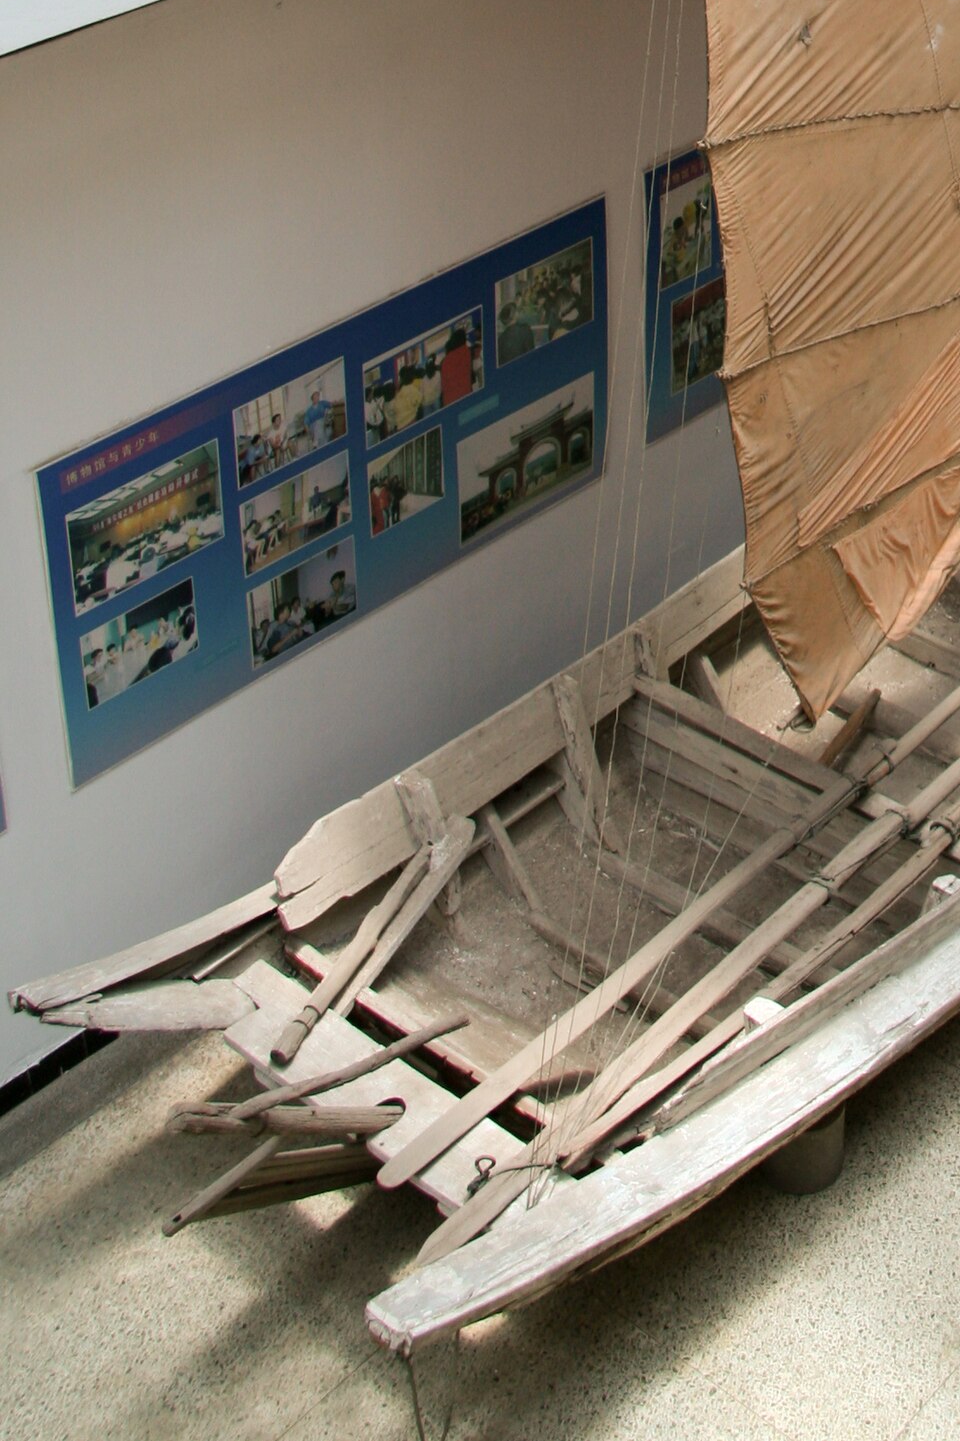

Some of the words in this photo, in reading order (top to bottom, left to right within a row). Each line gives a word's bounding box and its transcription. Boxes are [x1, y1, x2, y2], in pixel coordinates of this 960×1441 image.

[66, 430, 158, 486] 博物馆与青少年
